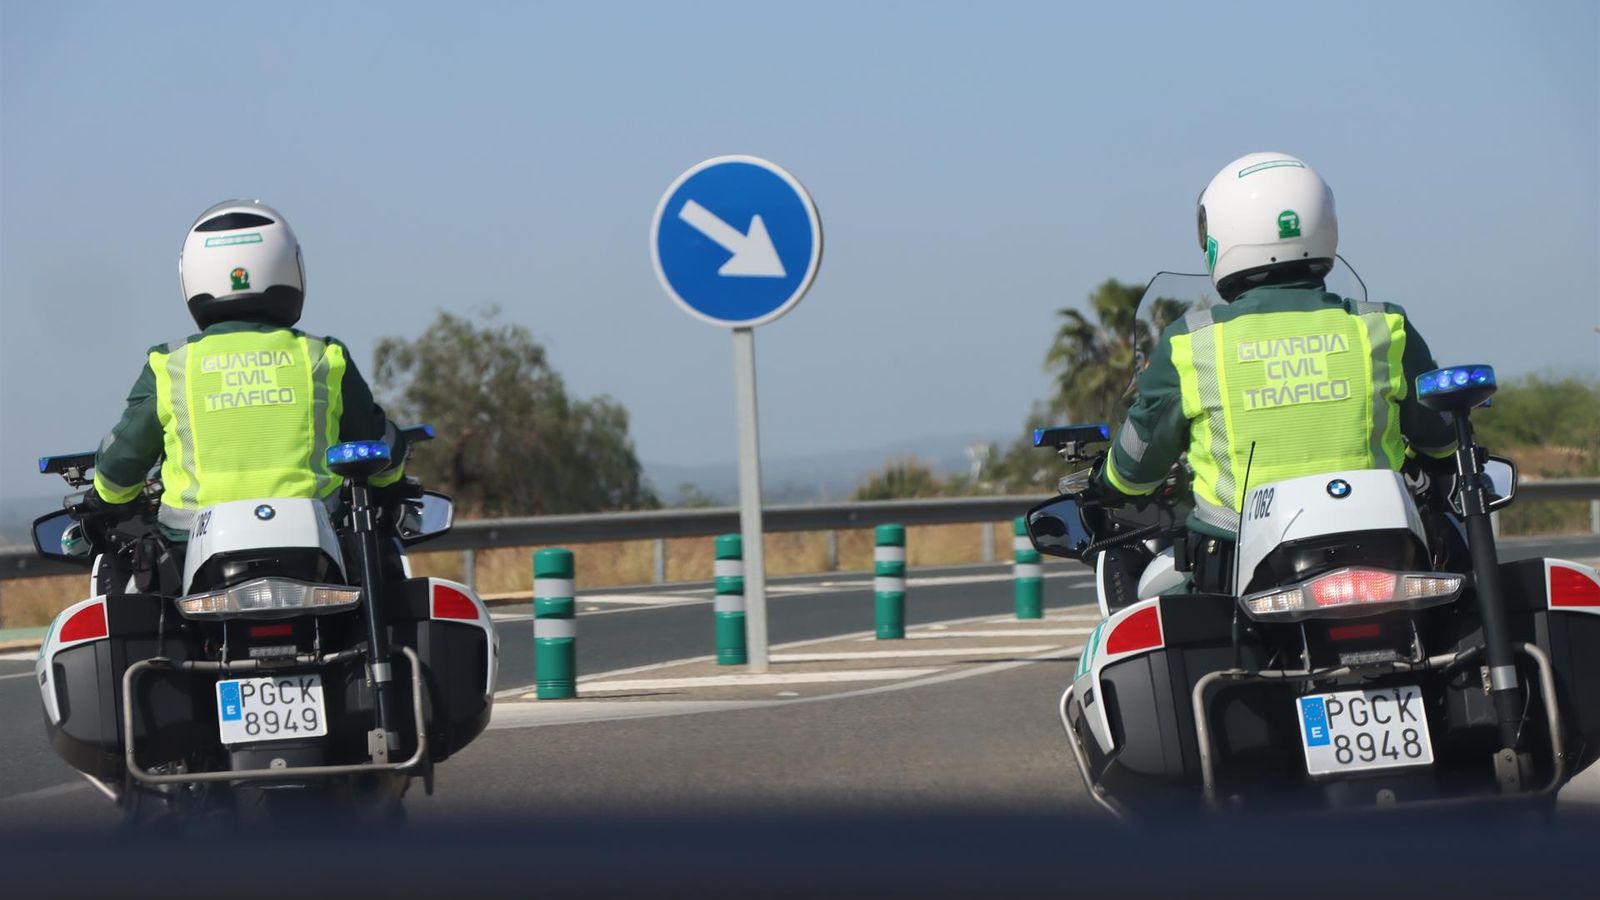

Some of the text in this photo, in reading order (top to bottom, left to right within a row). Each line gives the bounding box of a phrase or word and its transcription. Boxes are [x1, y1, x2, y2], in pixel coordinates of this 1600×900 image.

[1238, 333, 1346, 361] GUARDIA
[202, 351, 292, 371] GUARDIA
[1267, 358, 1323, 379] CIVIL
[225, 369, 272, 386] CIVIL
[207, 388, 293, 410] TRÁFICO
[1247, 380, 1349, 408] TRÁFICO
[240, 678, 316, 708] PGCK
[226, 705, 236, 715] E
[245, 707, 318, 736] 8949
[1325, 691, 1418, 730] PGCK
[1311, 726, 1323, 738] E
[1334, 728, 1423, 764] 8948
